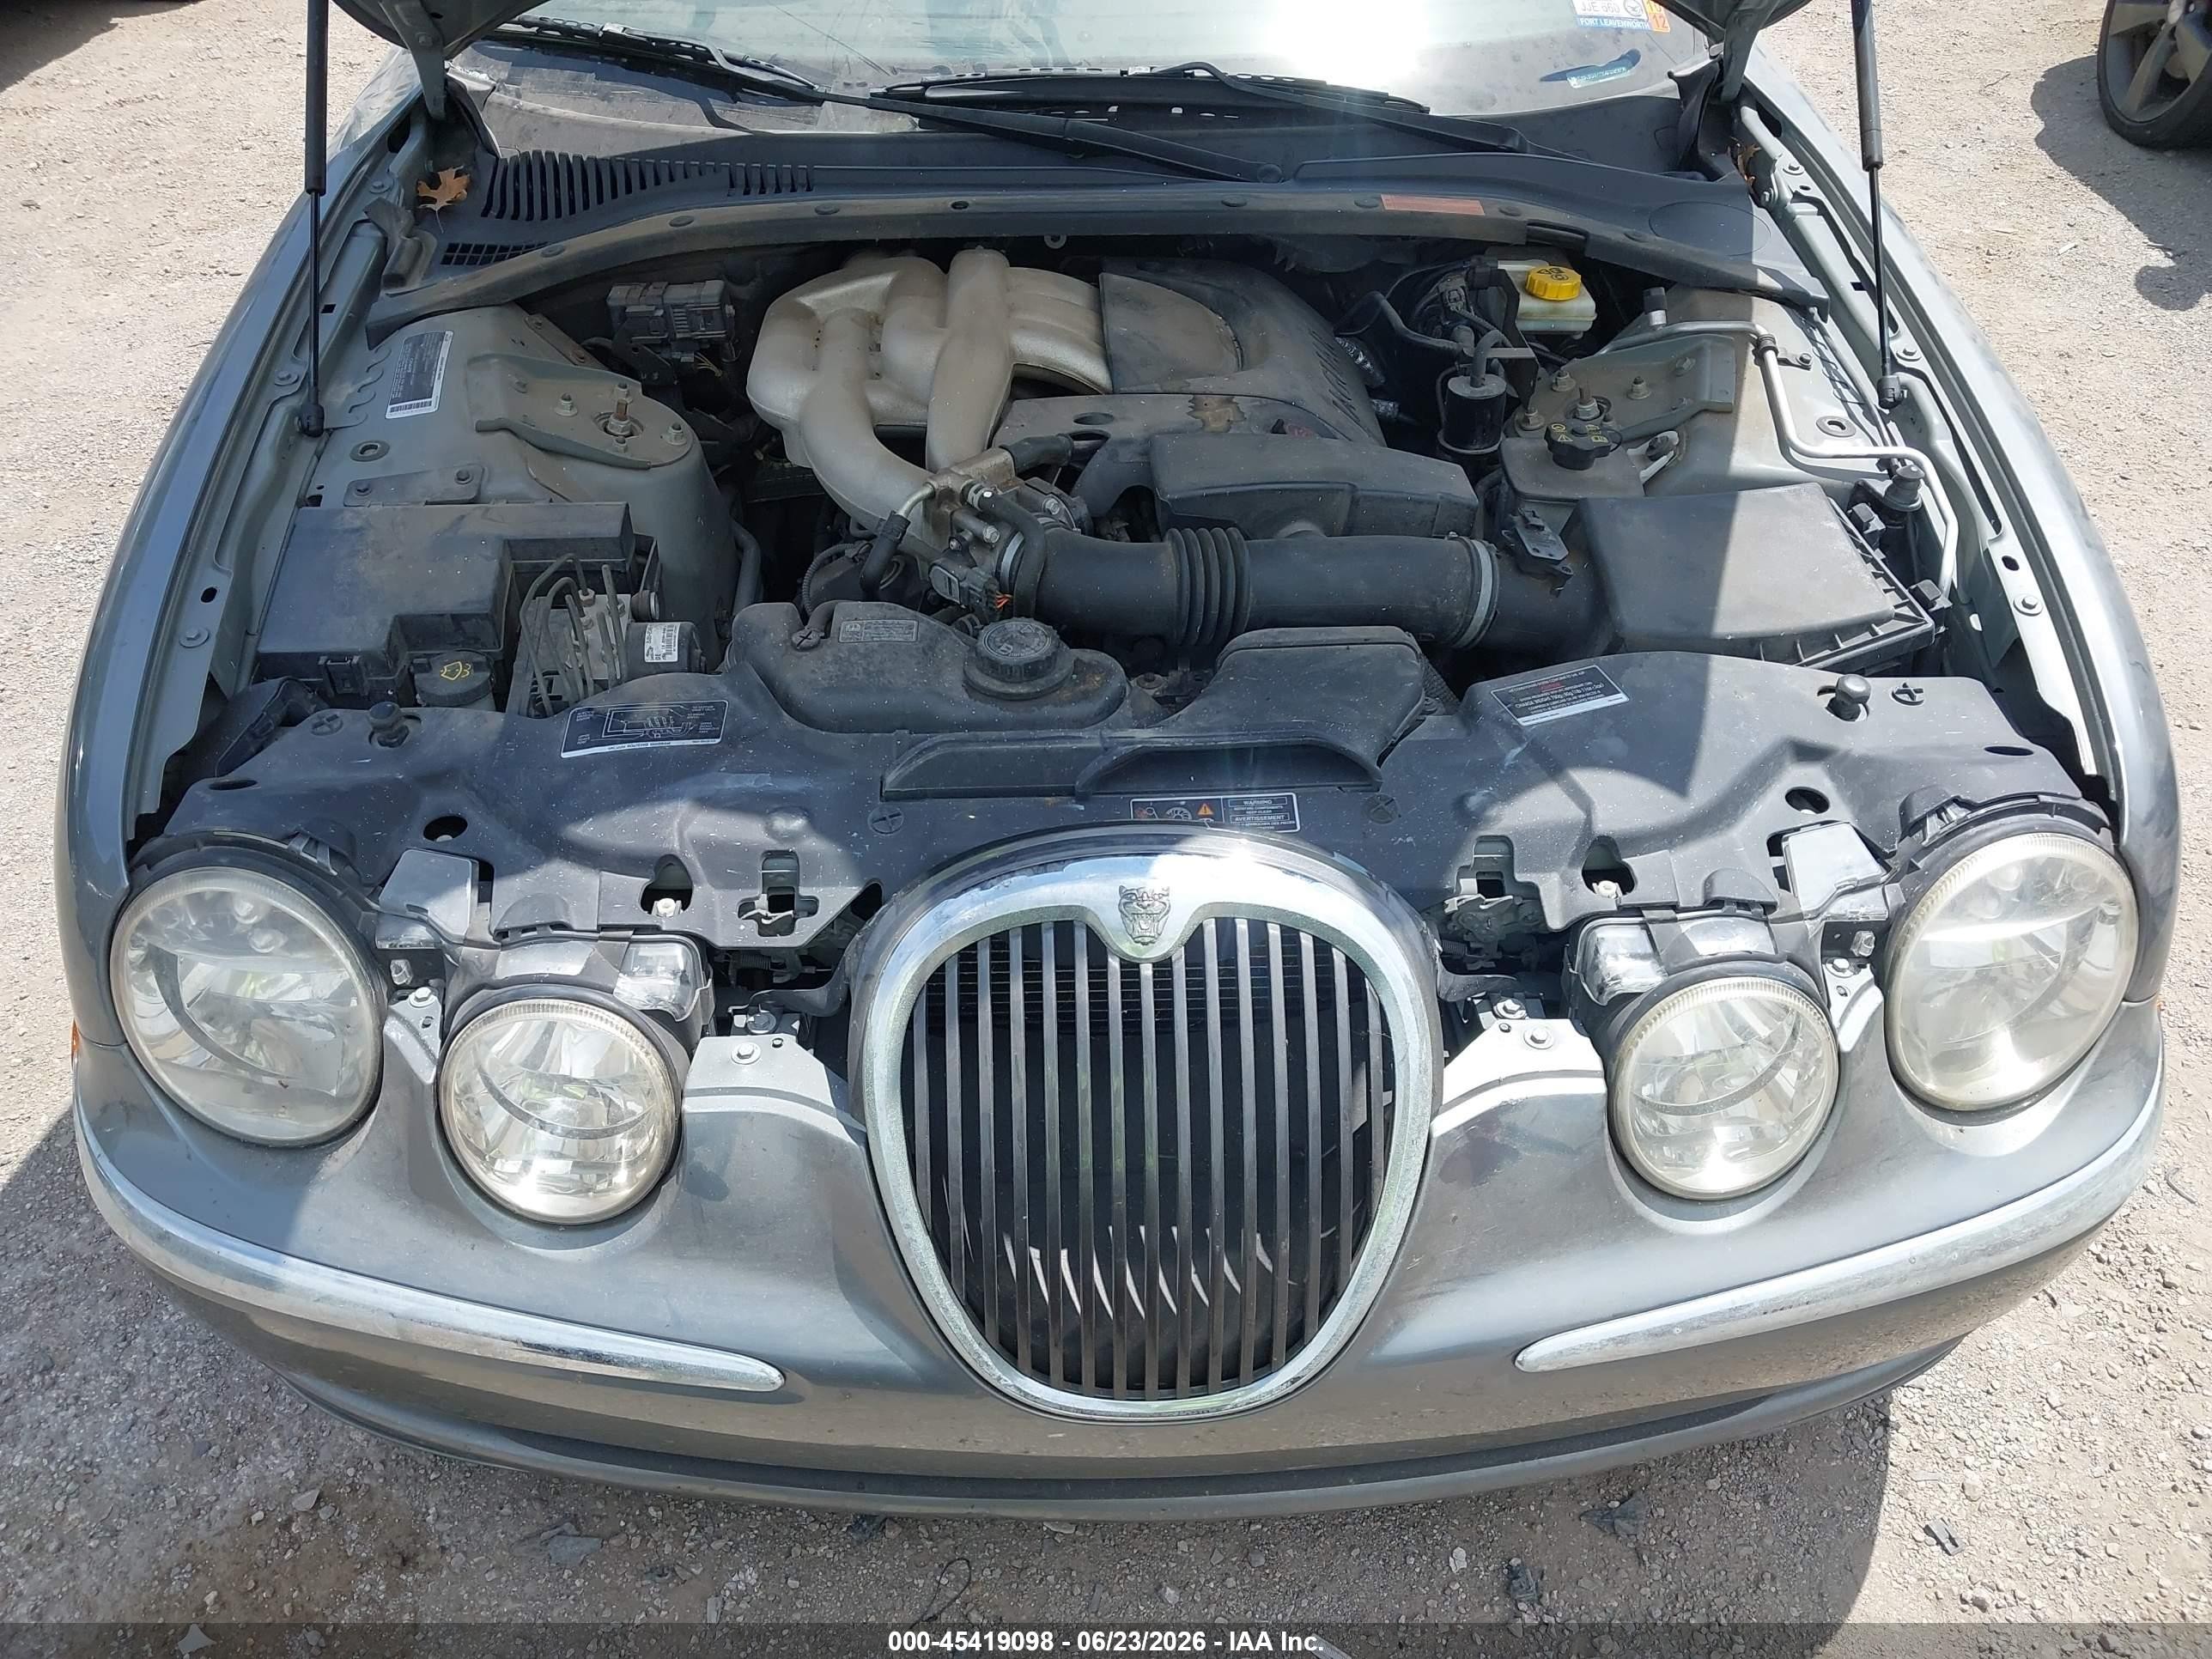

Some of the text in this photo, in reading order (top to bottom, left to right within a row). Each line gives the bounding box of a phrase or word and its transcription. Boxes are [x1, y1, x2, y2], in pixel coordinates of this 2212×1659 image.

[1580, 17, 1649, 29] FORT LEAVENWORTH
[1652, 14, 1668, 29] 12
